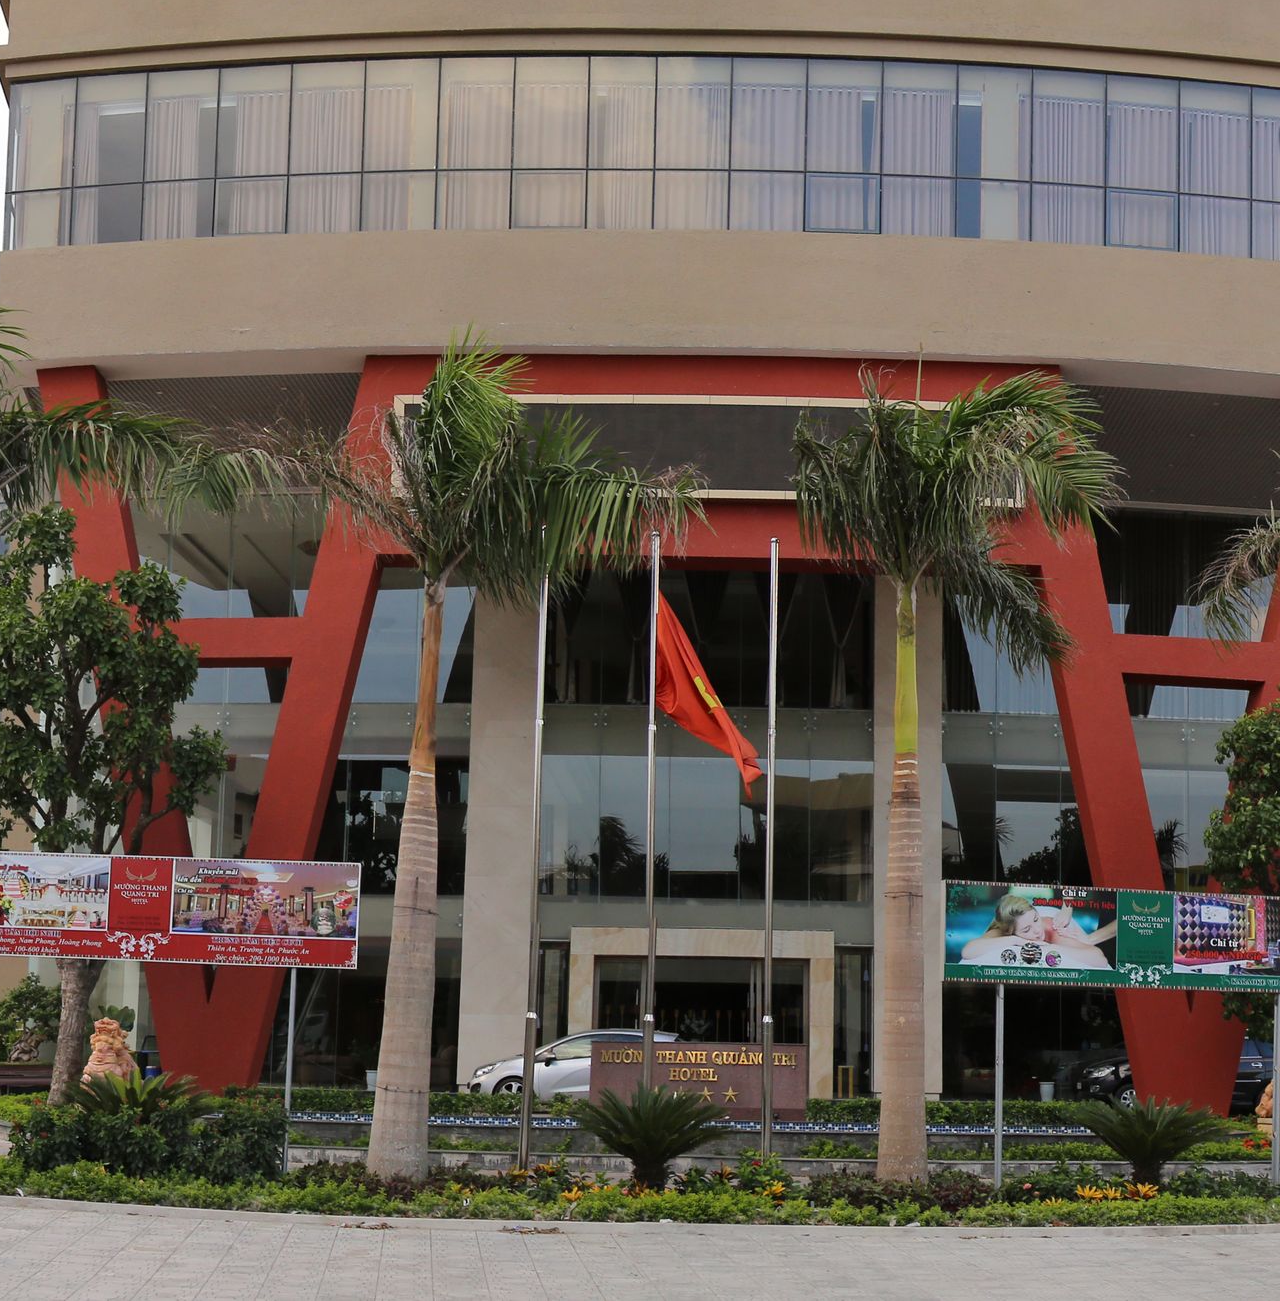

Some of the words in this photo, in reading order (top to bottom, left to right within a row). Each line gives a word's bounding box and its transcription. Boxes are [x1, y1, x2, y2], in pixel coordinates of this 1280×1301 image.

[121, 891, 146, 899] QUANG
[1129, 922, 1151, 930] QUANG
[41, 946, 60, 954] khách
[600, 1046, 643, 1063] MƯỜN
[656, 1050, 707, 1064] THANH
[773, 1052, 796, 1069] TRỊ
[669, 1067, 718, 1081] HOTEL
